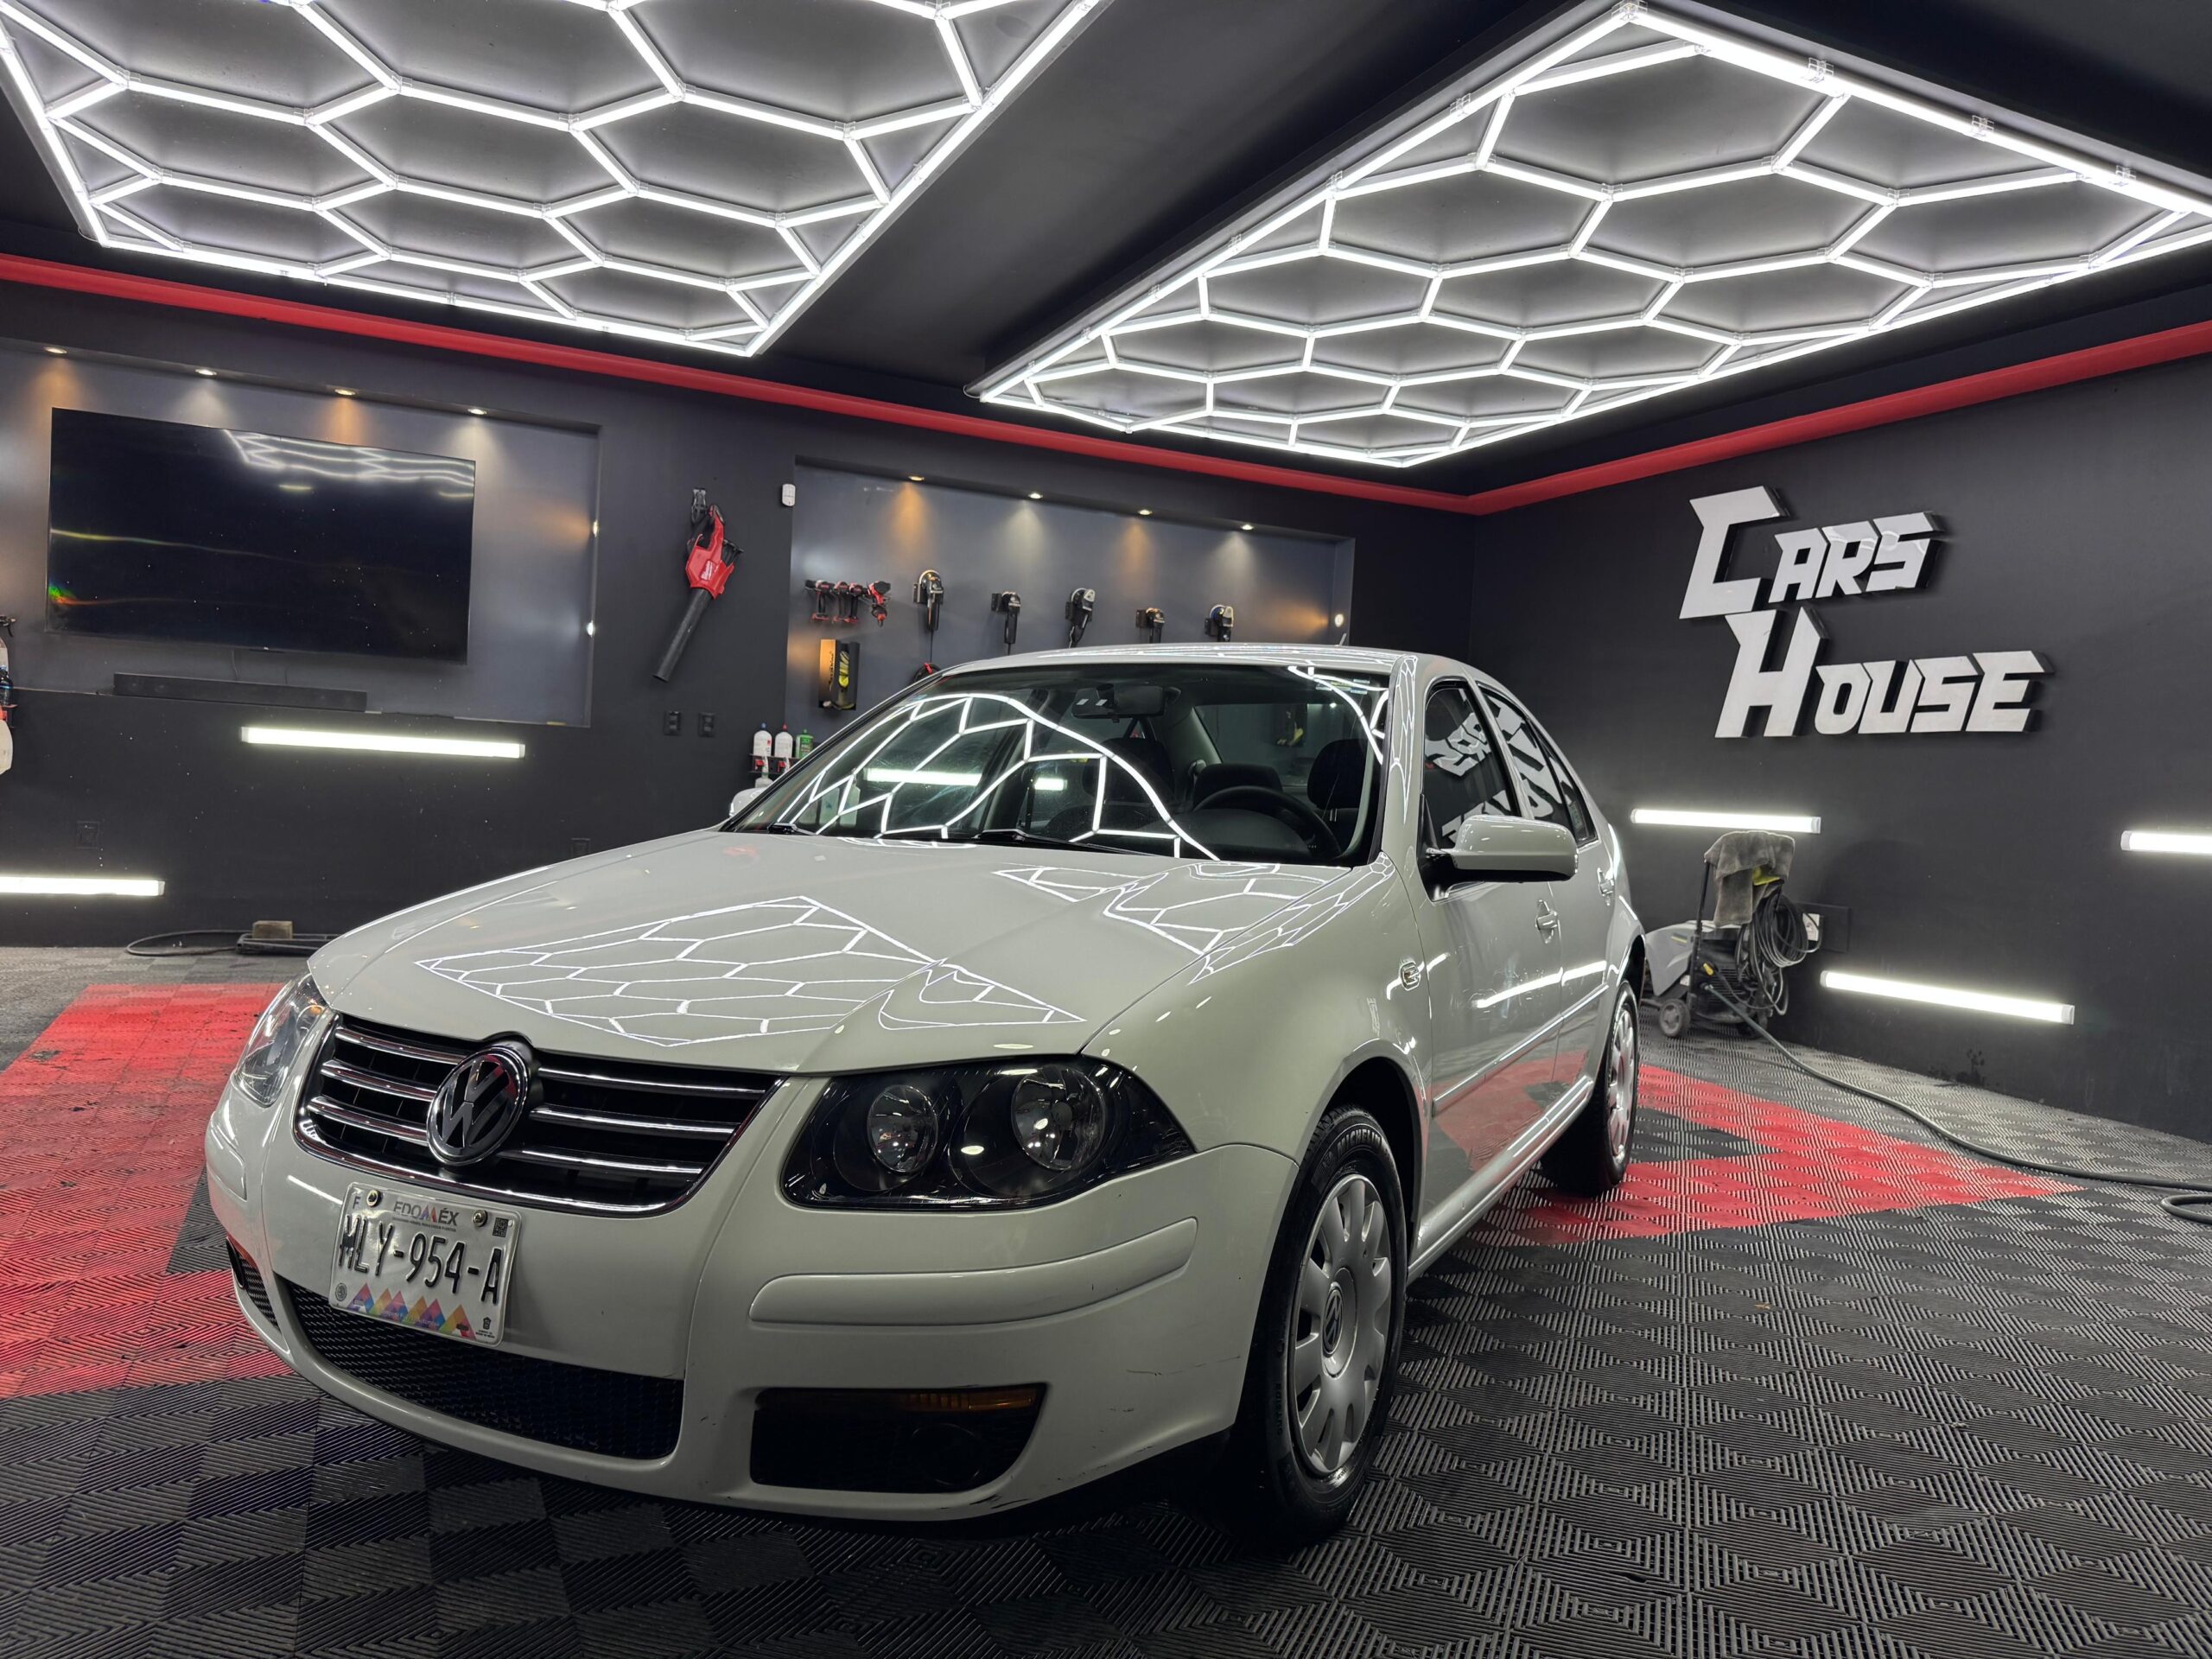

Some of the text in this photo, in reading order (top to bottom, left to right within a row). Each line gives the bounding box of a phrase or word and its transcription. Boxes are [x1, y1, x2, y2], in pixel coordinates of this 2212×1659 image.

[1679, 486, 1941, 620] CARS
[1714, 607, 2048, 739] HOUSE
[1337, 1128, 1382, 1159] MICHELIN
[338, 1214, 503, 1305] MLY-954-A
